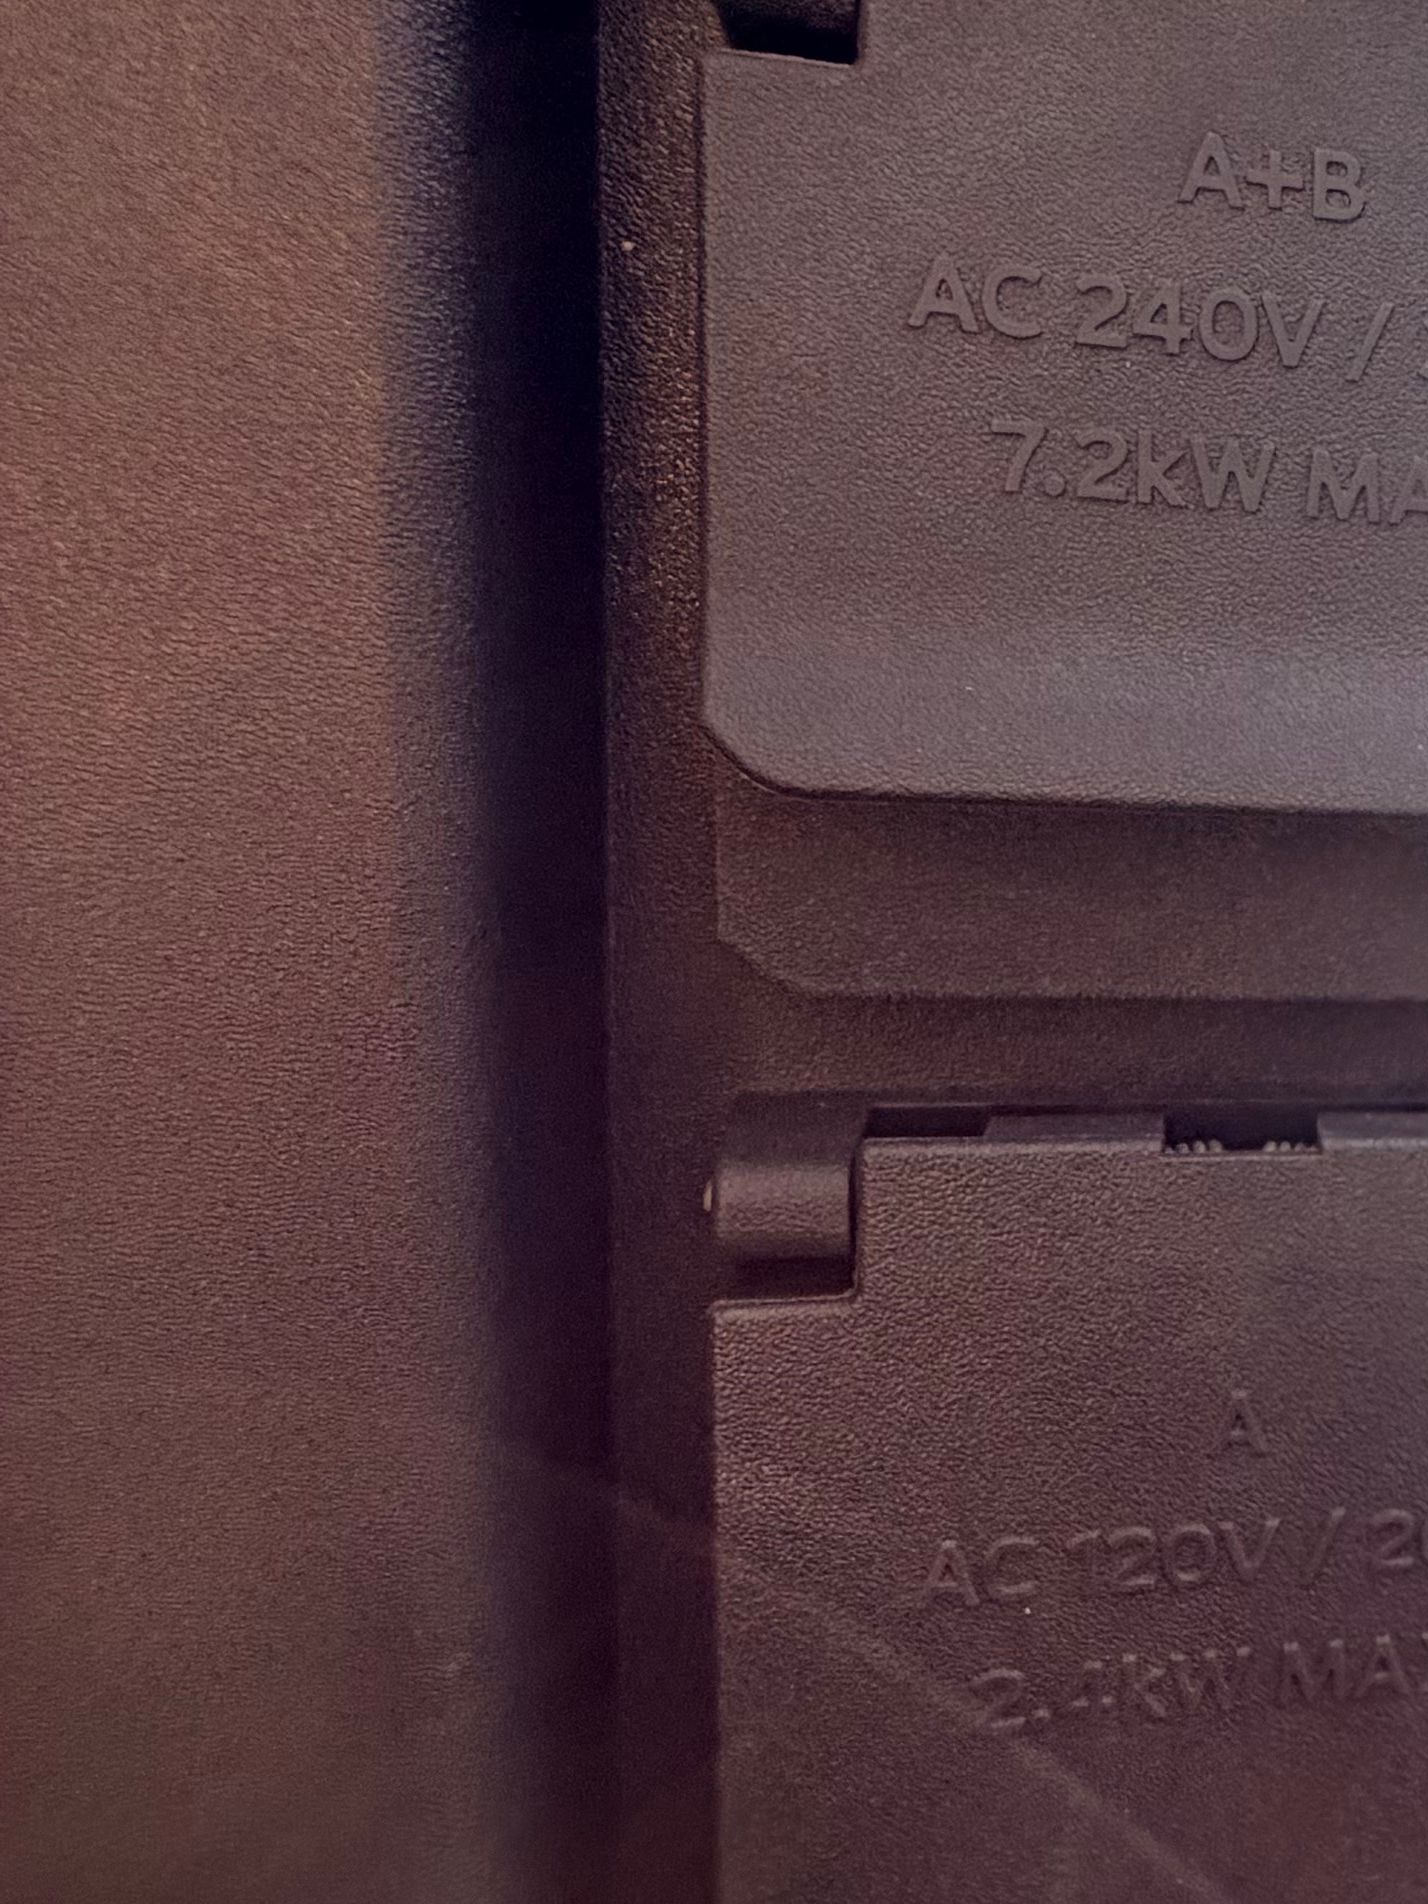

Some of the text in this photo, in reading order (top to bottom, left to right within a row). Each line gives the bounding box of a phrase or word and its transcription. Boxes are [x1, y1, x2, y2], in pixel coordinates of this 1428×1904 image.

[1178, 130, 1368, 224] A+B
[908, 252, 1043, 339] AC
[1074, 272, 1327, 369] 240V
[1347, 300, 1392, 383] /
[991, 417, 1277, 515] 7.2kW
[1214, 1385, 1272, 1458] A
[918, 1537, 1039, 1609] AC
[1065, 1515, 1283, 1595] 120V
